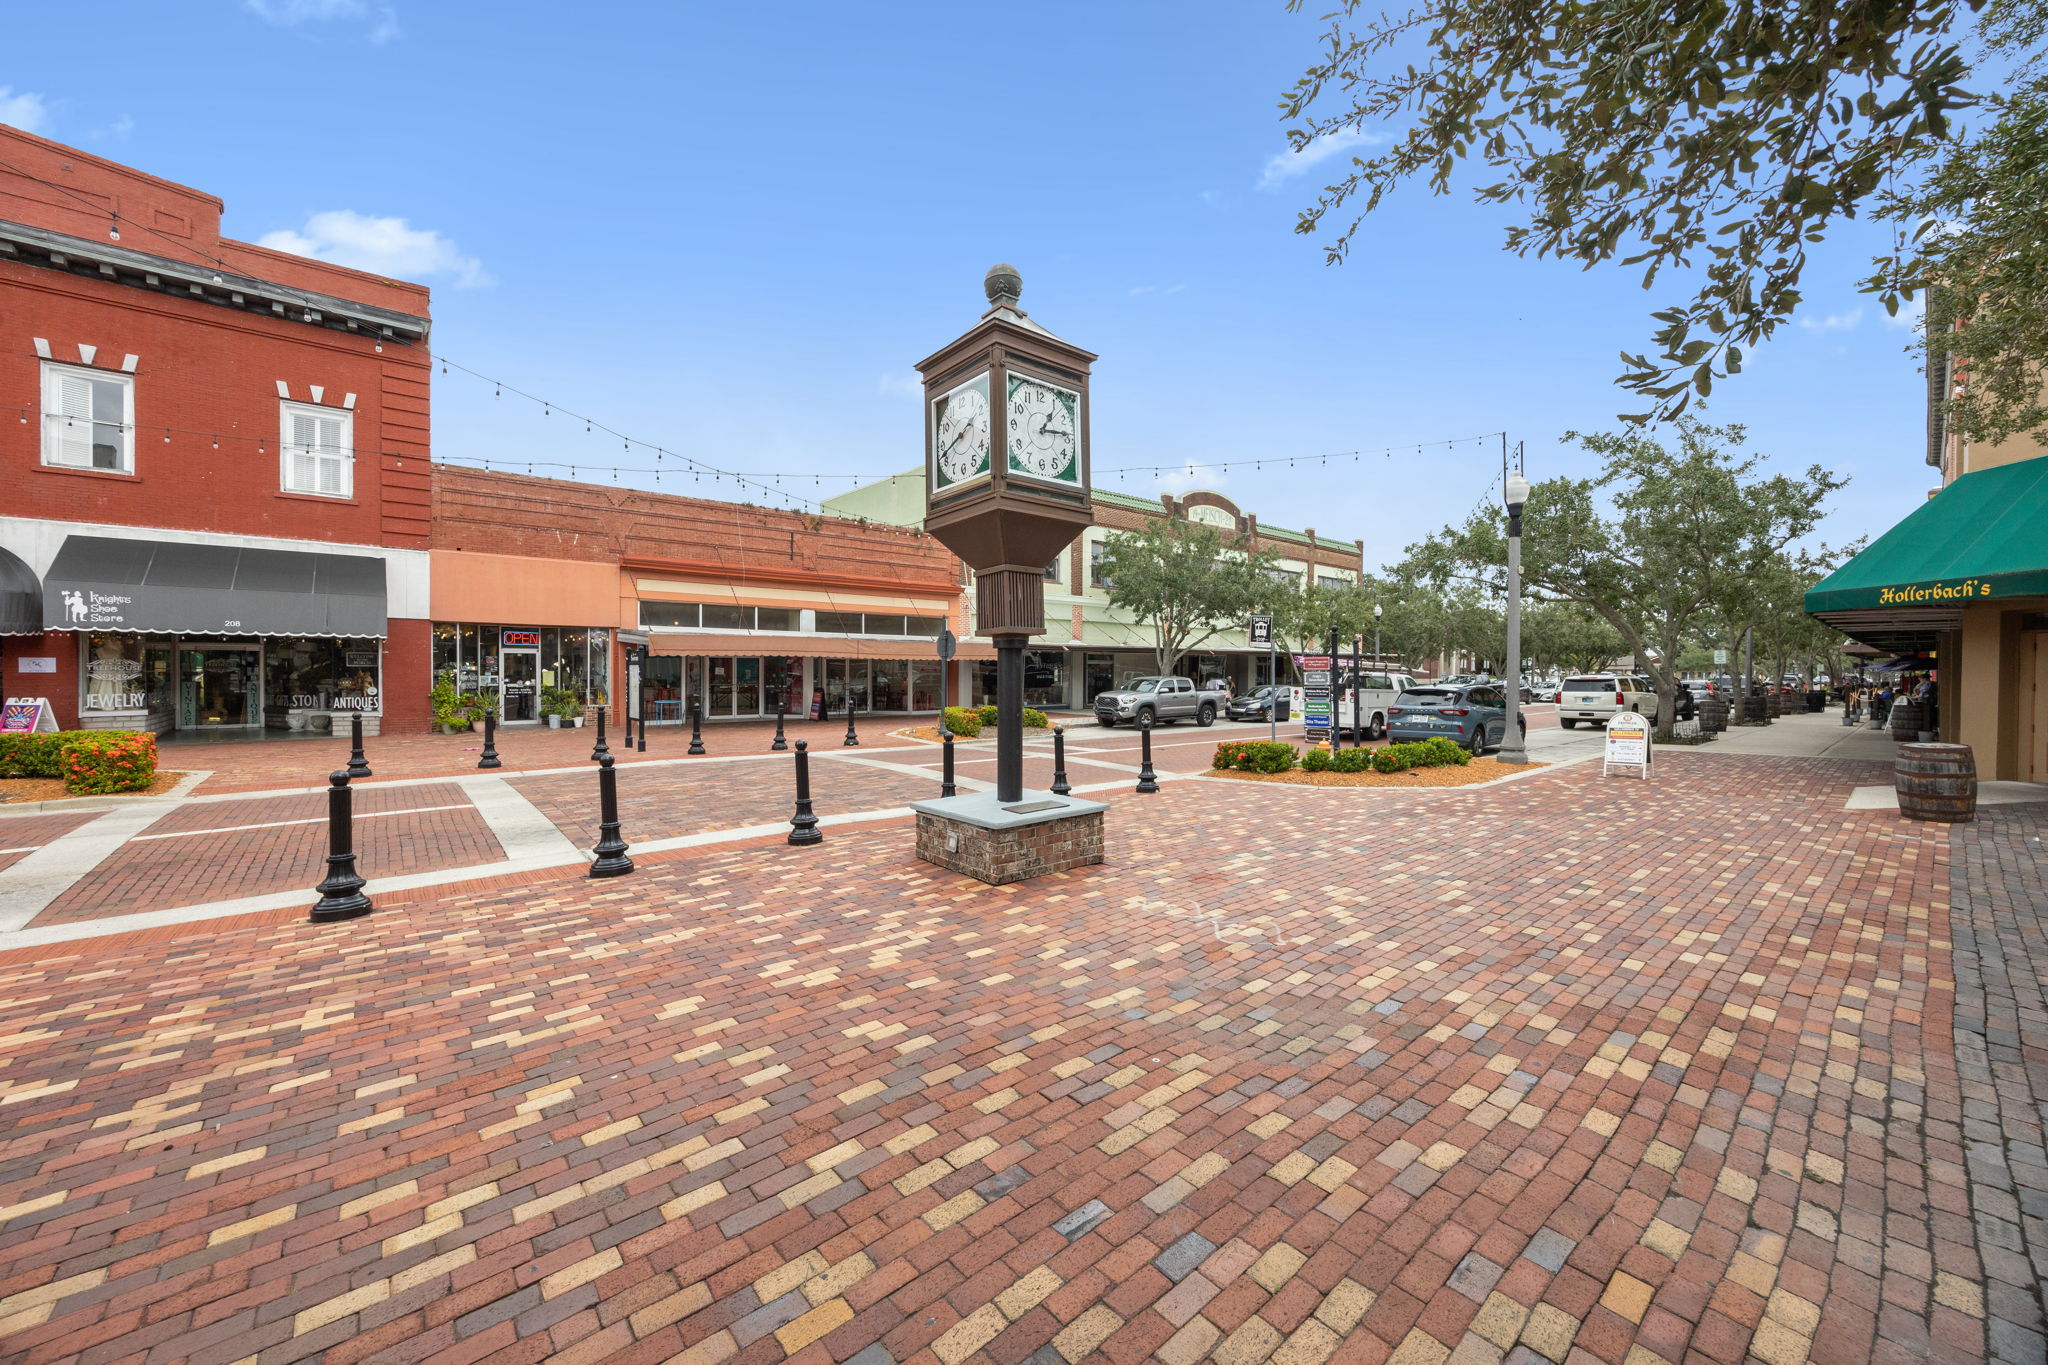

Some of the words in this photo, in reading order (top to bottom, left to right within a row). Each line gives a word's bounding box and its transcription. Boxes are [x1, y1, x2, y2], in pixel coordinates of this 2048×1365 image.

[959, 396, 966, 409] 12
[1024, 390, 1031, 404] 11
[1036, 390, 1045, 403] 12
[949, 406, 955, 418] 11
[979, 405, 984, 415] 2
[1014, 401, 1024, 415] 10
[1010, 418, 1018, 431] 9
[1061, 414, 1067, 425] 2
[942, 422, 949, 435] 10
[981, 421, 987, 433] 3
[940, 440, 946, 451] 9
[978, 439, 985, 451] 4
[1016, 438, 1022, 450] 8
[970, 454, 977, 467] 5
[1026, 451, 1033, 464] 7
[1060, 448, 1067, 460] 4
[951, 463, 957, 475] 7
[960, 463, 967, 475] 6
[1038, 458, 1046, 471] 6
[1051, 457, 1059, 470] 5
[1879, 579, 1991, 604] Hollerbach's
[90, 604, 119, 614] Shoe
[90, 613, 124, 622] Store
[505, 632, 538, 645] OPEN
[84, 693, 146, 709] JEWELRY
[333, 696, 379, 710] ANTIQUES
